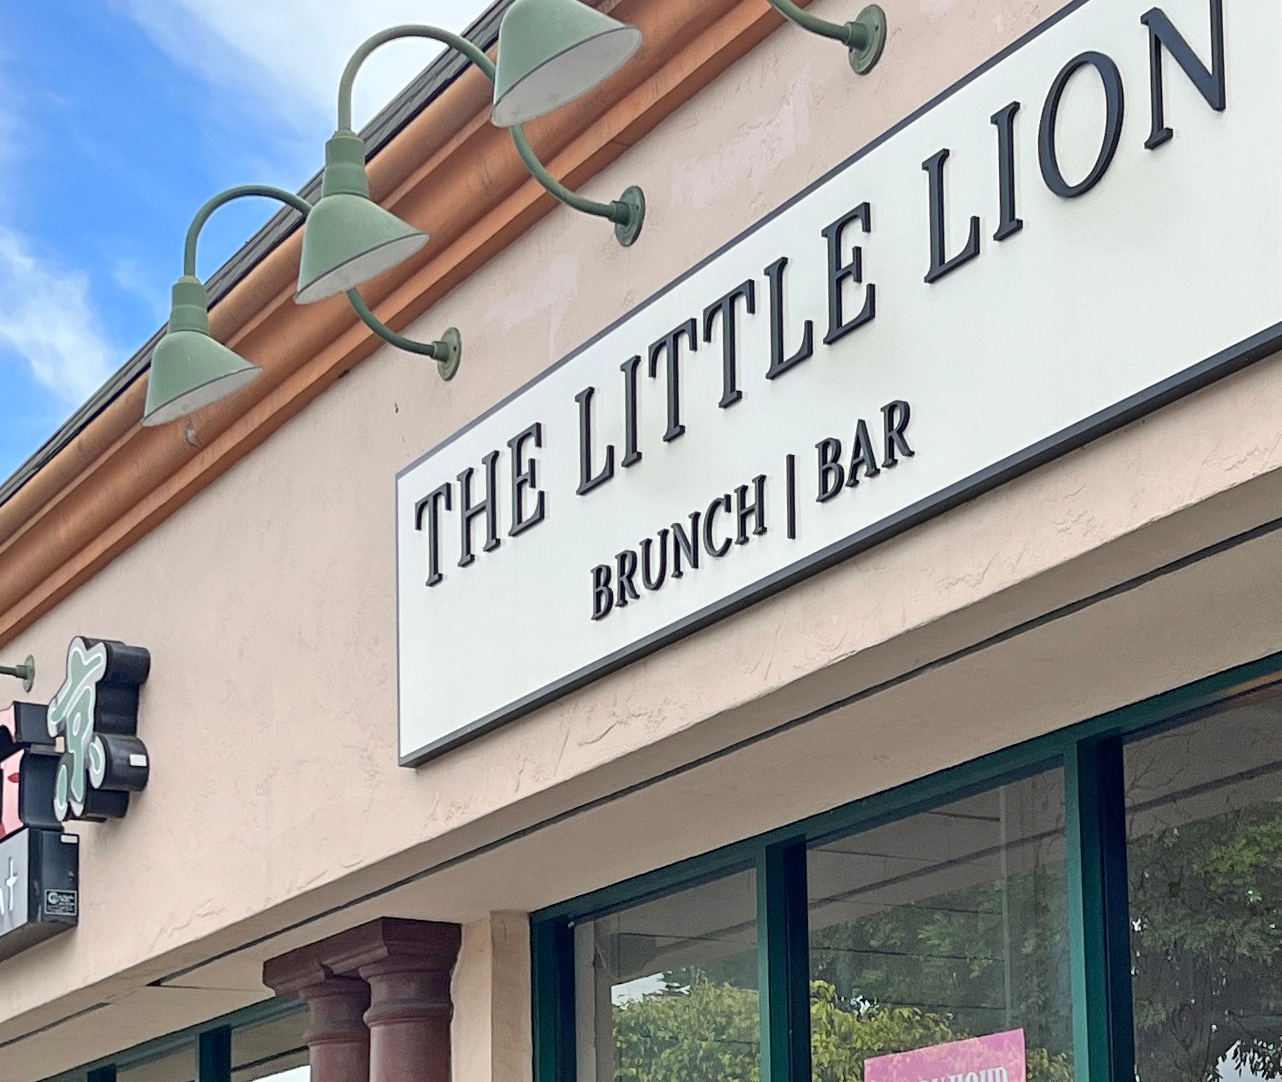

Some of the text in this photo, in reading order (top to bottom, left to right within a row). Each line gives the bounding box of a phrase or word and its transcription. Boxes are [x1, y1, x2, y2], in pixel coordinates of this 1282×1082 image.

[414, 0, 1227, 587] THE LITTLE LION
[591, 474, 768, 620] BRUNCH
[815, 400, 915, 503] BAR
